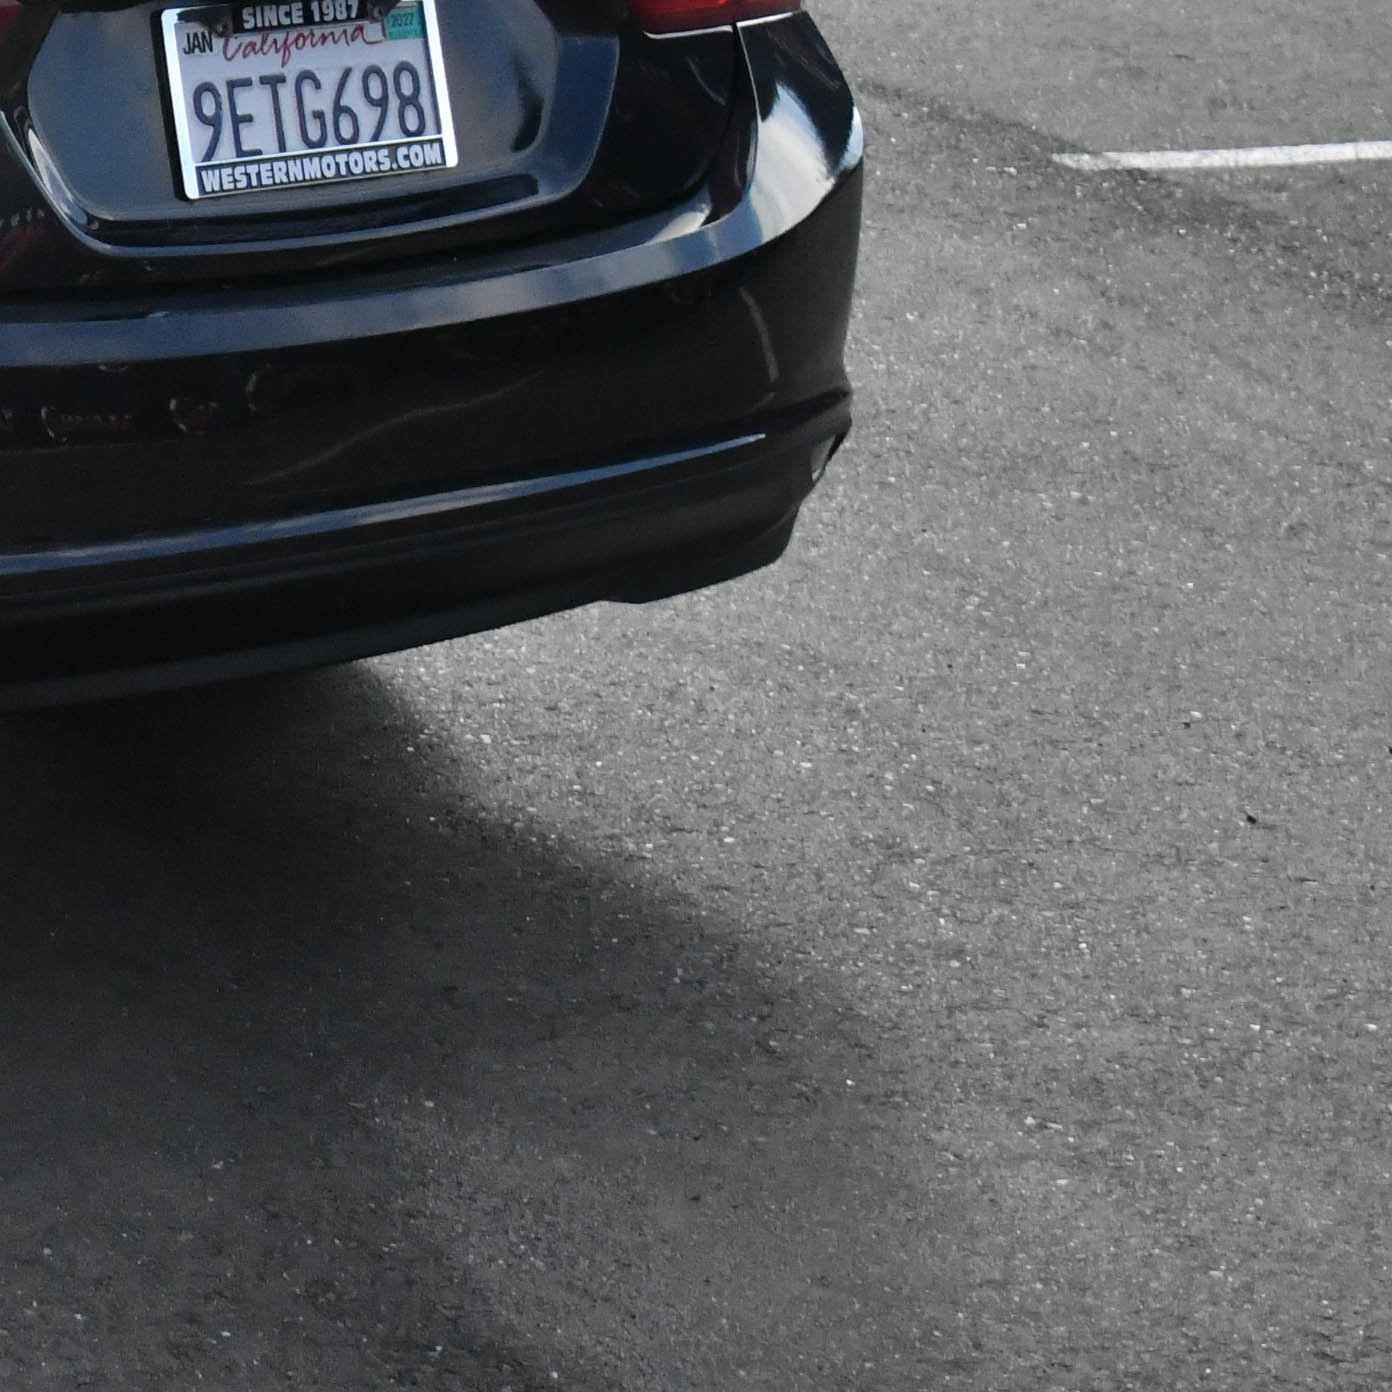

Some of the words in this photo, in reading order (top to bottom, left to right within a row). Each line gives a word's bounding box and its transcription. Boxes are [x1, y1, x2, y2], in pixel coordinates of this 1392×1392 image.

[242, 2, 304, 29] SINCE
[183, 31, 213, 55] JAN
[222, 22, 386, 68] California
[192, 61, 426, 163] 9ETG698
[200, 142, 443, 194] WESTERNMOTORS.COM
